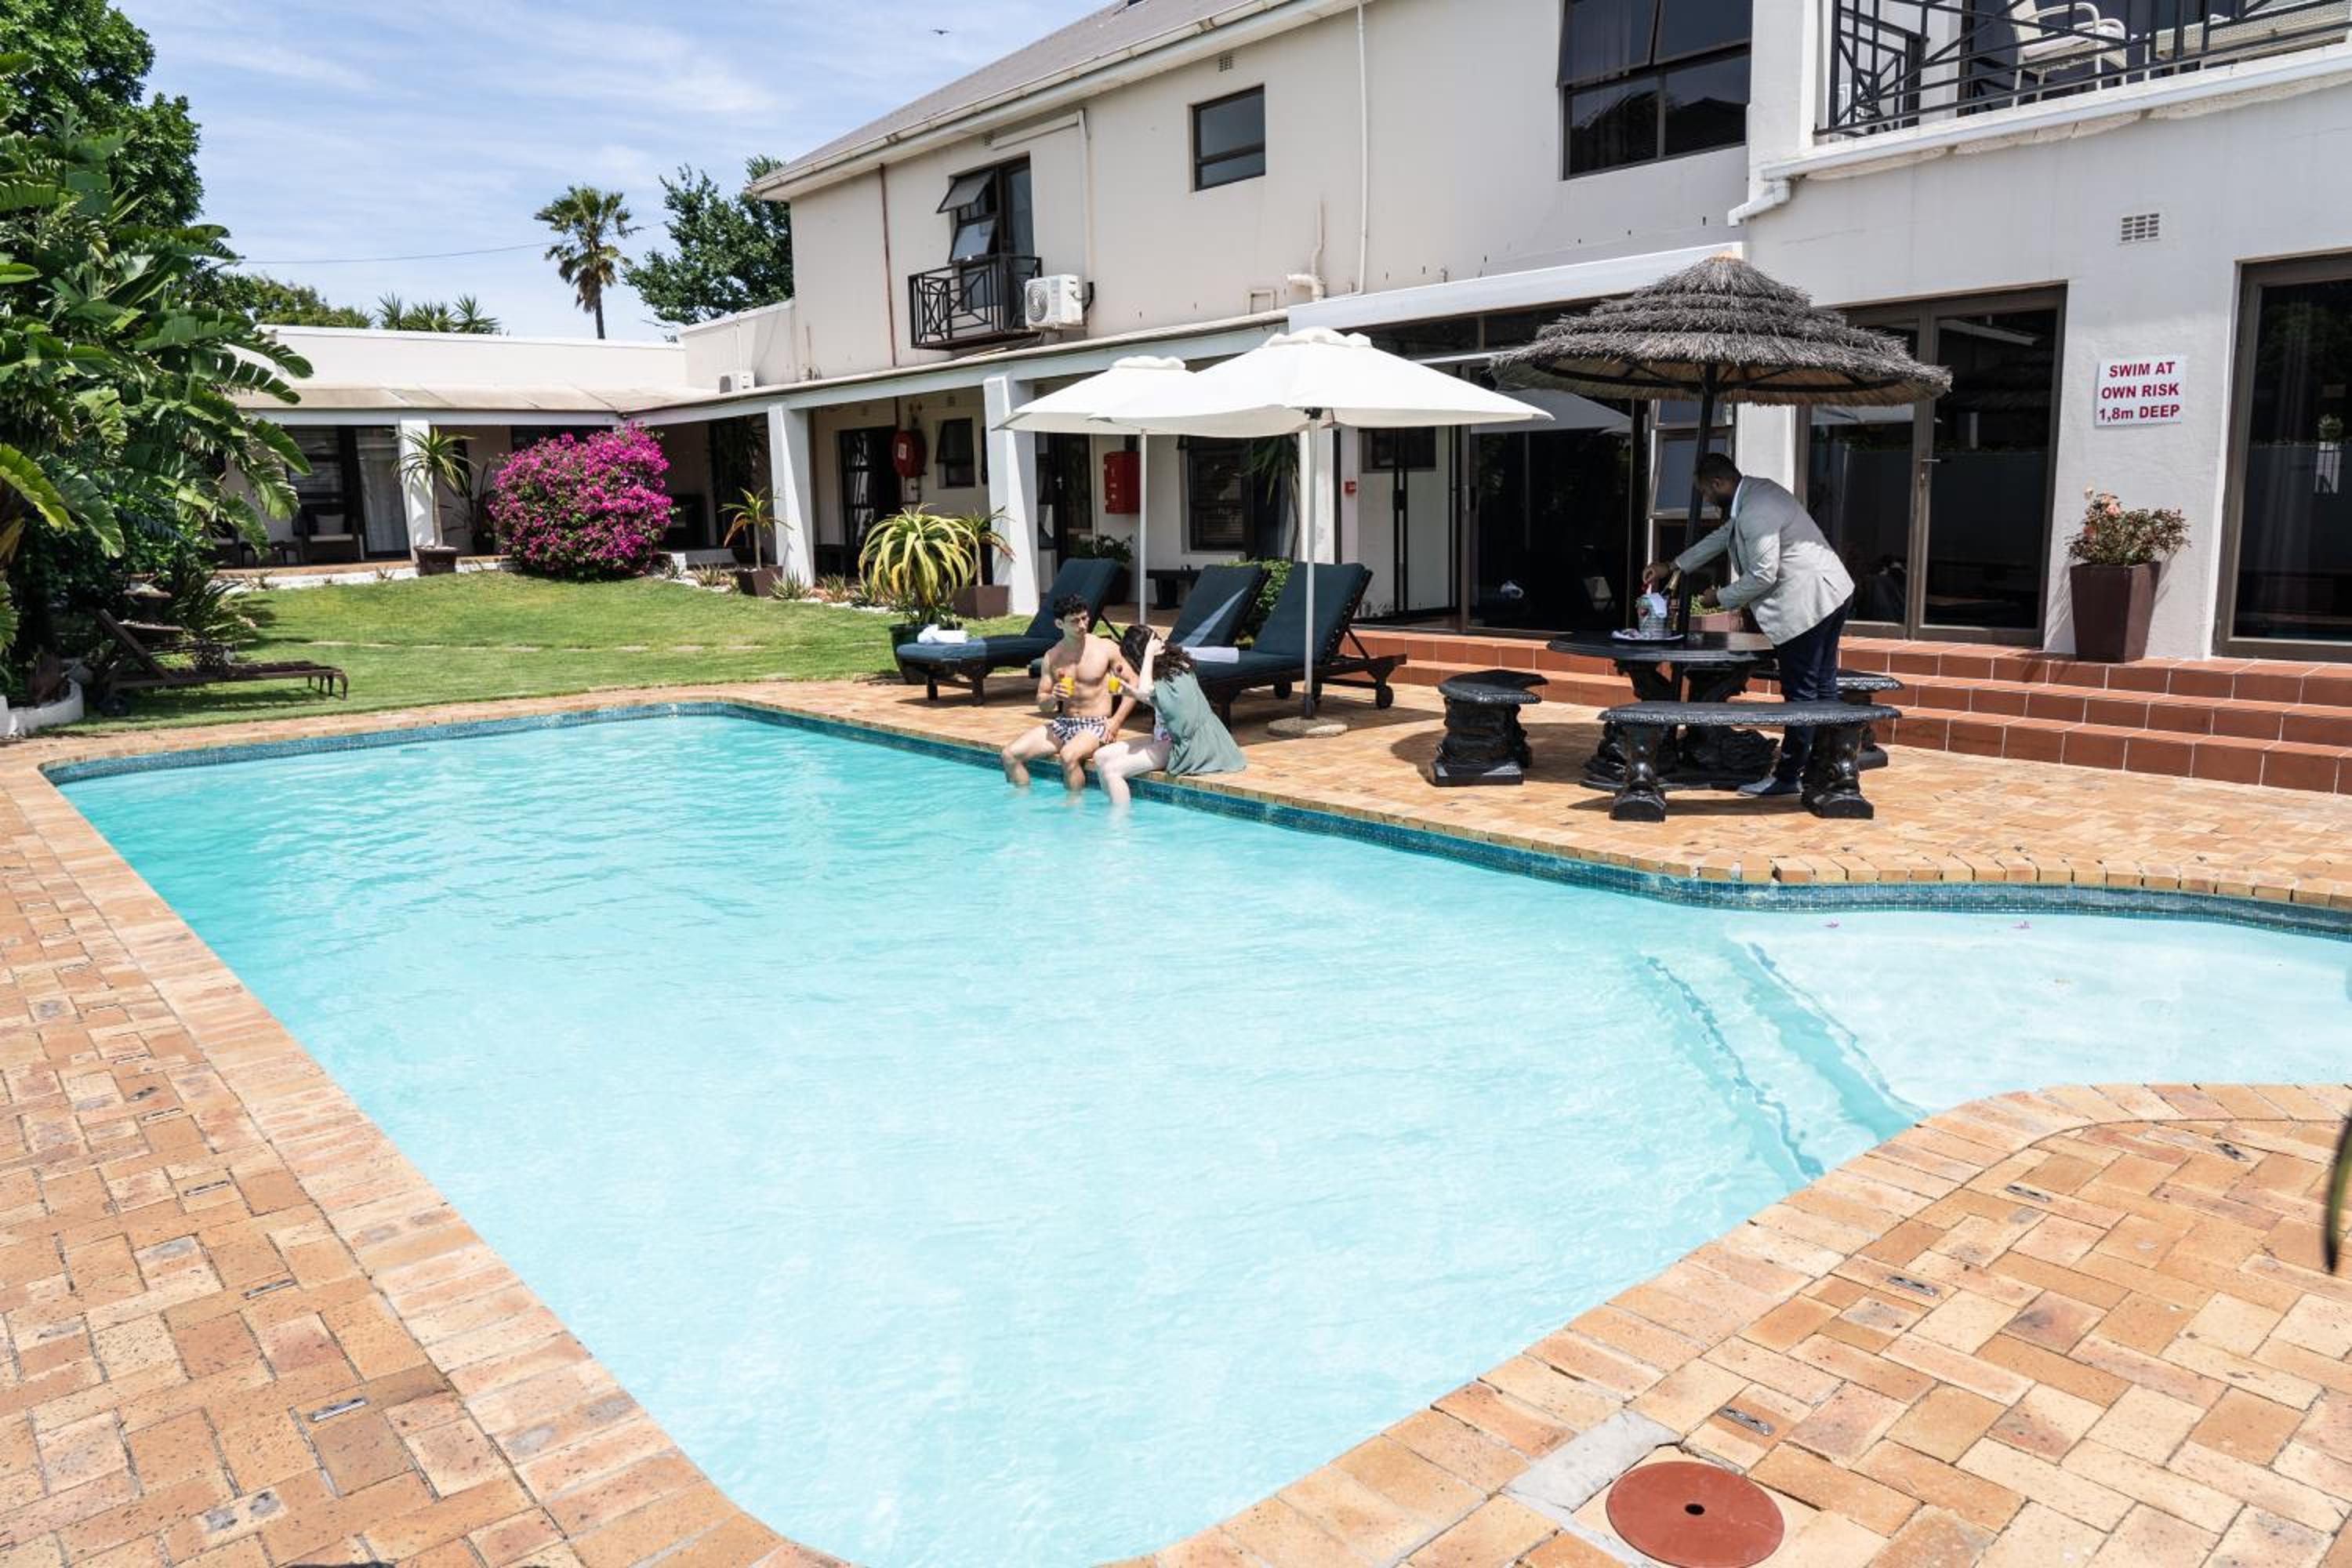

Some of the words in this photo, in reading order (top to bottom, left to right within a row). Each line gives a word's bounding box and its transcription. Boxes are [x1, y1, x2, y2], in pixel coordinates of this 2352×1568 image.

[2109, 363, 2151, 377] SWIM
[2155, 361, 2176, 375] AT
[2101, 386, 2136, 399] OWN
[2141, 383, 2180, 397] RISK
[2099, 407, 2133, 423] 1,8m
[2139, 404, 2180, 418] DEEP
